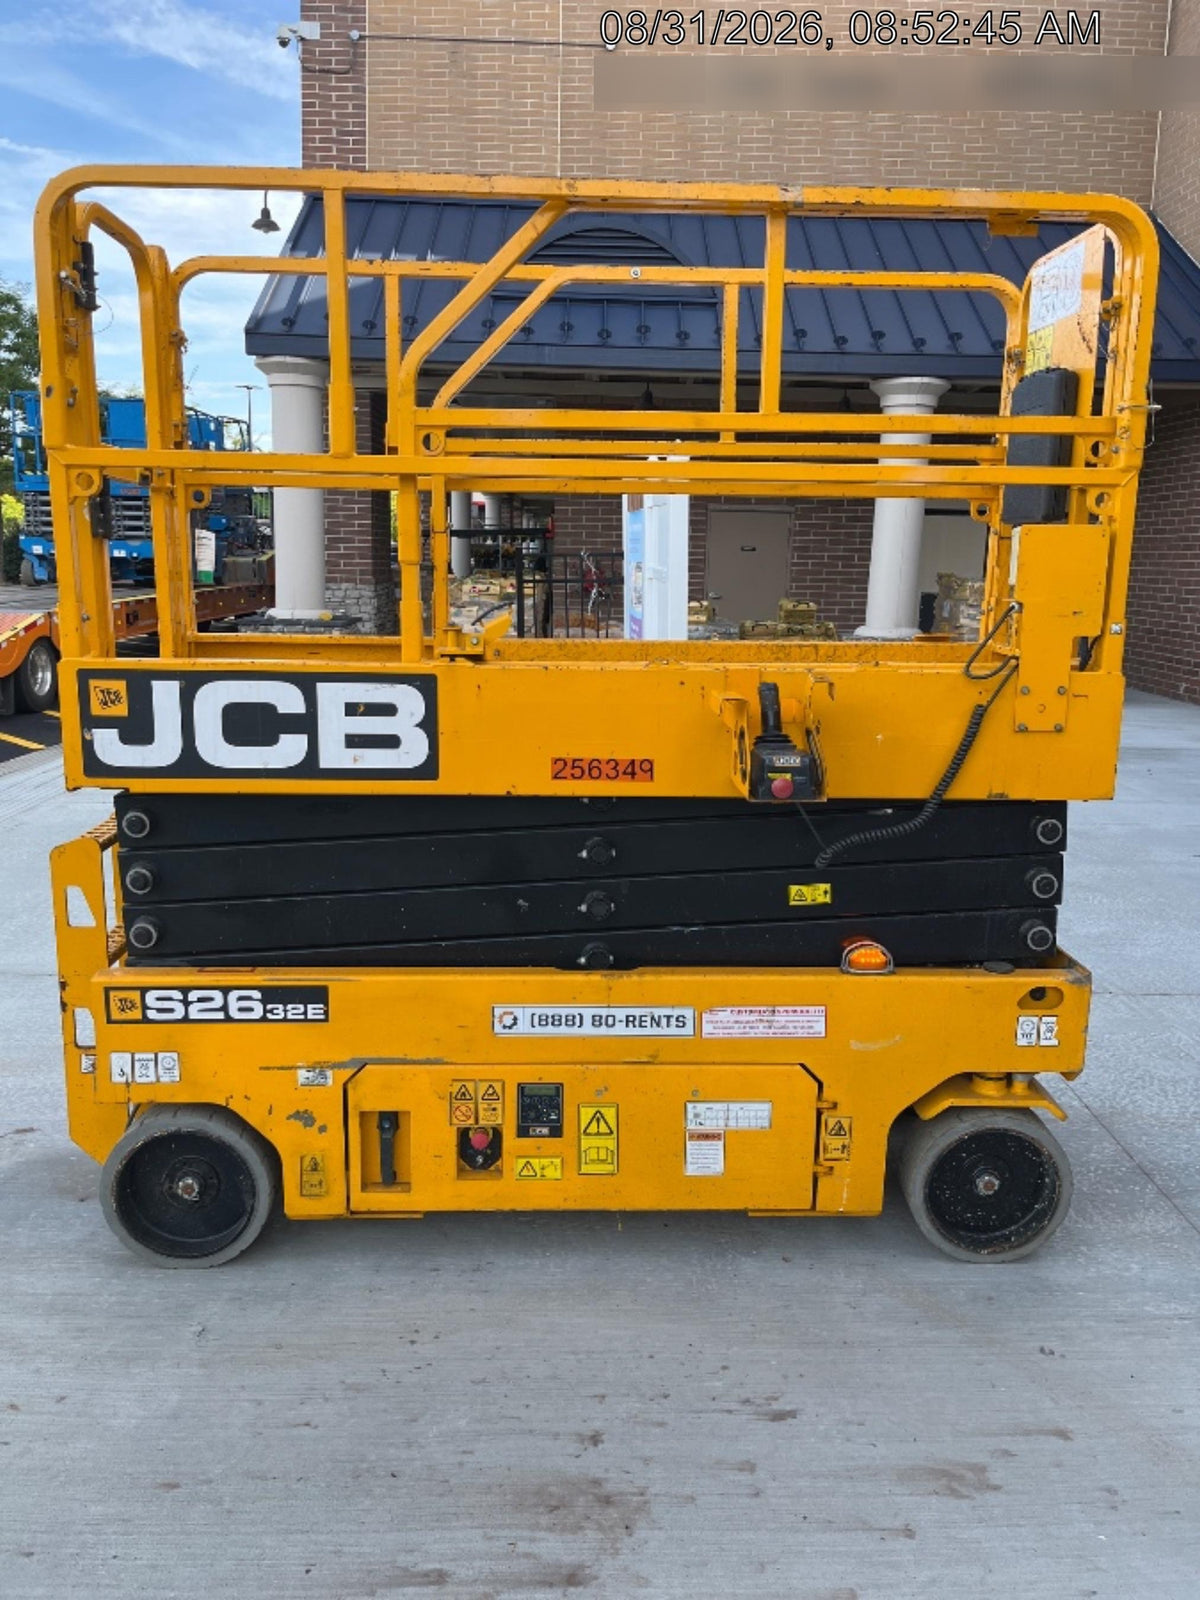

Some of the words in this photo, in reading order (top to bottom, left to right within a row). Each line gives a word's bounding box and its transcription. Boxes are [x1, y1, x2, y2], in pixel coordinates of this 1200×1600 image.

[91, 680, 430, 770] JCB
[552, 757, 654, 780] 256349
[530, 1012, 584, 1029] (888)
[591, 1014, 687, 1029] 80-RENTS
